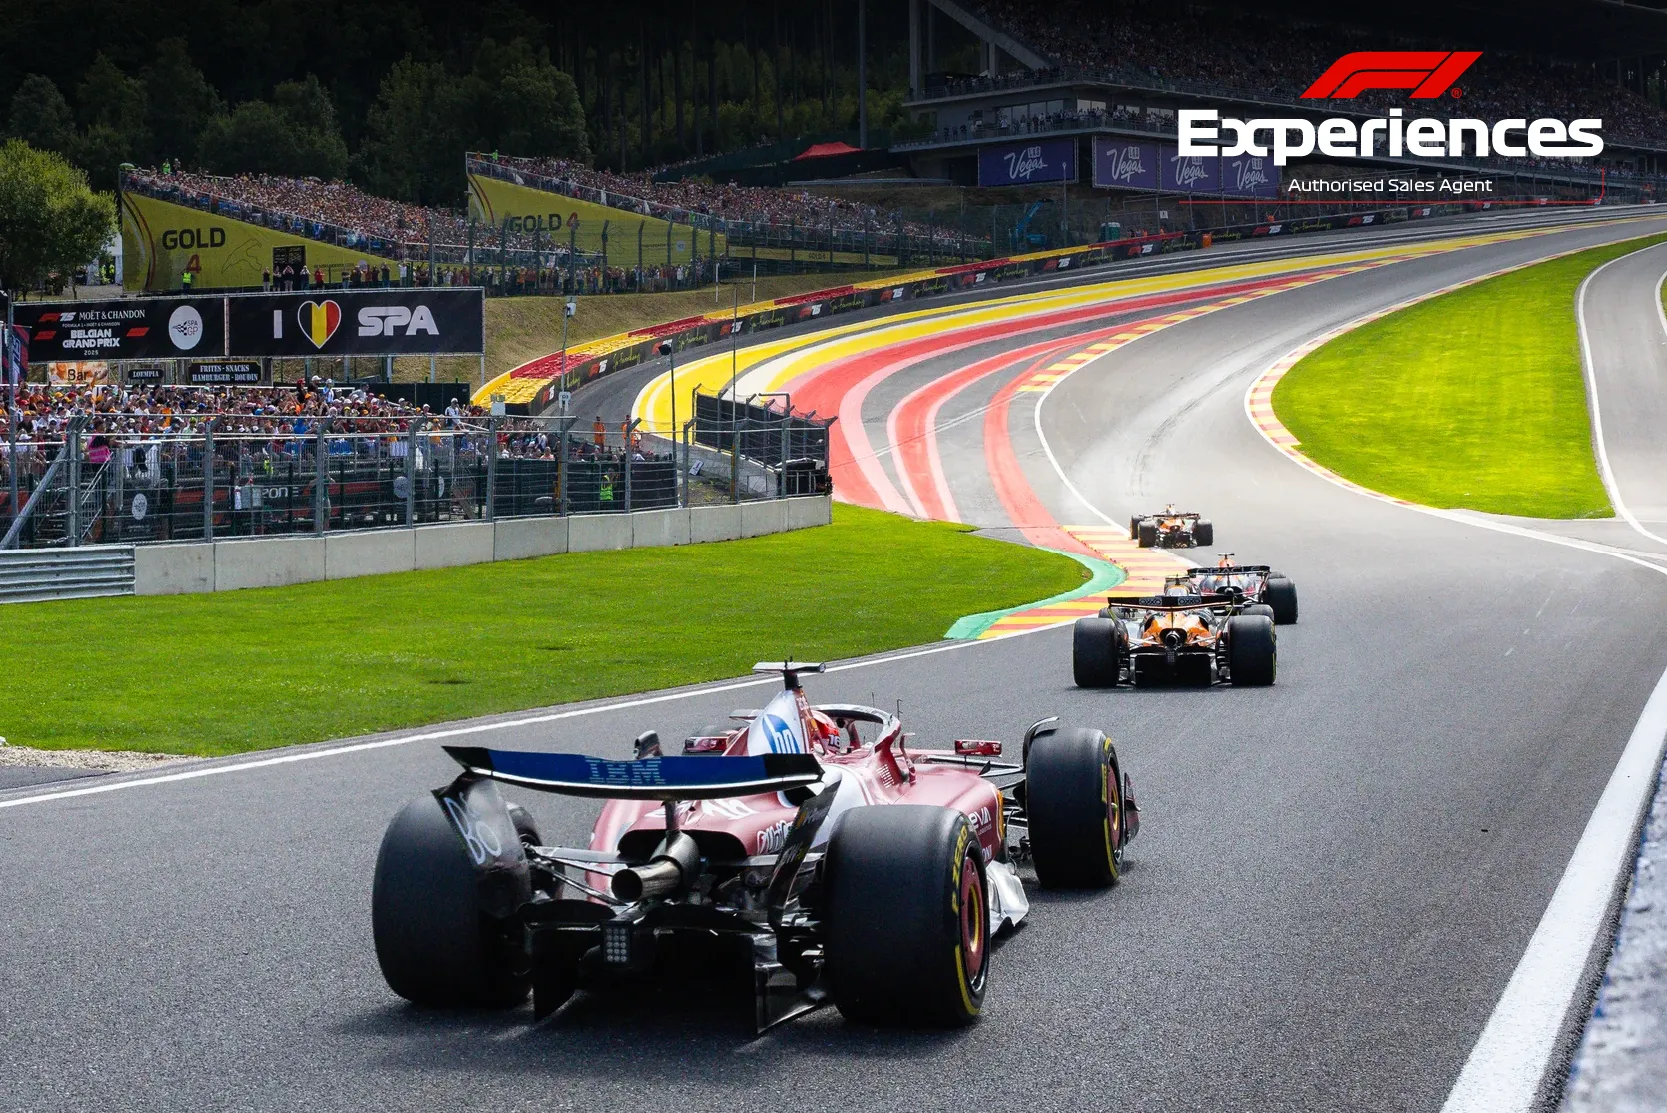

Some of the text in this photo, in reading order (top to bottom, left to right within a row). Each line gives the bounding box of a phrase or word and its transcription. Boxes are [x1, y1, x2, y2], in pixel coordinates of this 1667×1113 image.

[1004, 149, 1048, 180] Vegas
[1107, 149, 1146, 183] Vegas
[1171, 156, 1208, 188] Vegas
[1232, 159, 1268, 192] Vegas
[509, 213, 562, 233] GOLD
[162, 227, 226, 250] GOLD
[186, 253, 202, 274] 4
[60, 311, 77, 322] 75
[79, 309, 146, 320] MOËT & CHANDON
[273, 305, 440, 339] I SPA
[70, 328, 112, 339] BELGIAN
[187, 327, 199, 336] GP
[62, 337, 121, 349] GRAND PRIX
[67, 368, 89, 381] Bar
[200, 364, 222, 373] FRITES
[225, 364, 250, 372] SNACKS
[192, 373, 231, 382] HAMBURGER
[1196, 565, 1261, 574] ORACLE
[584, 756, 667, 785] IBM
